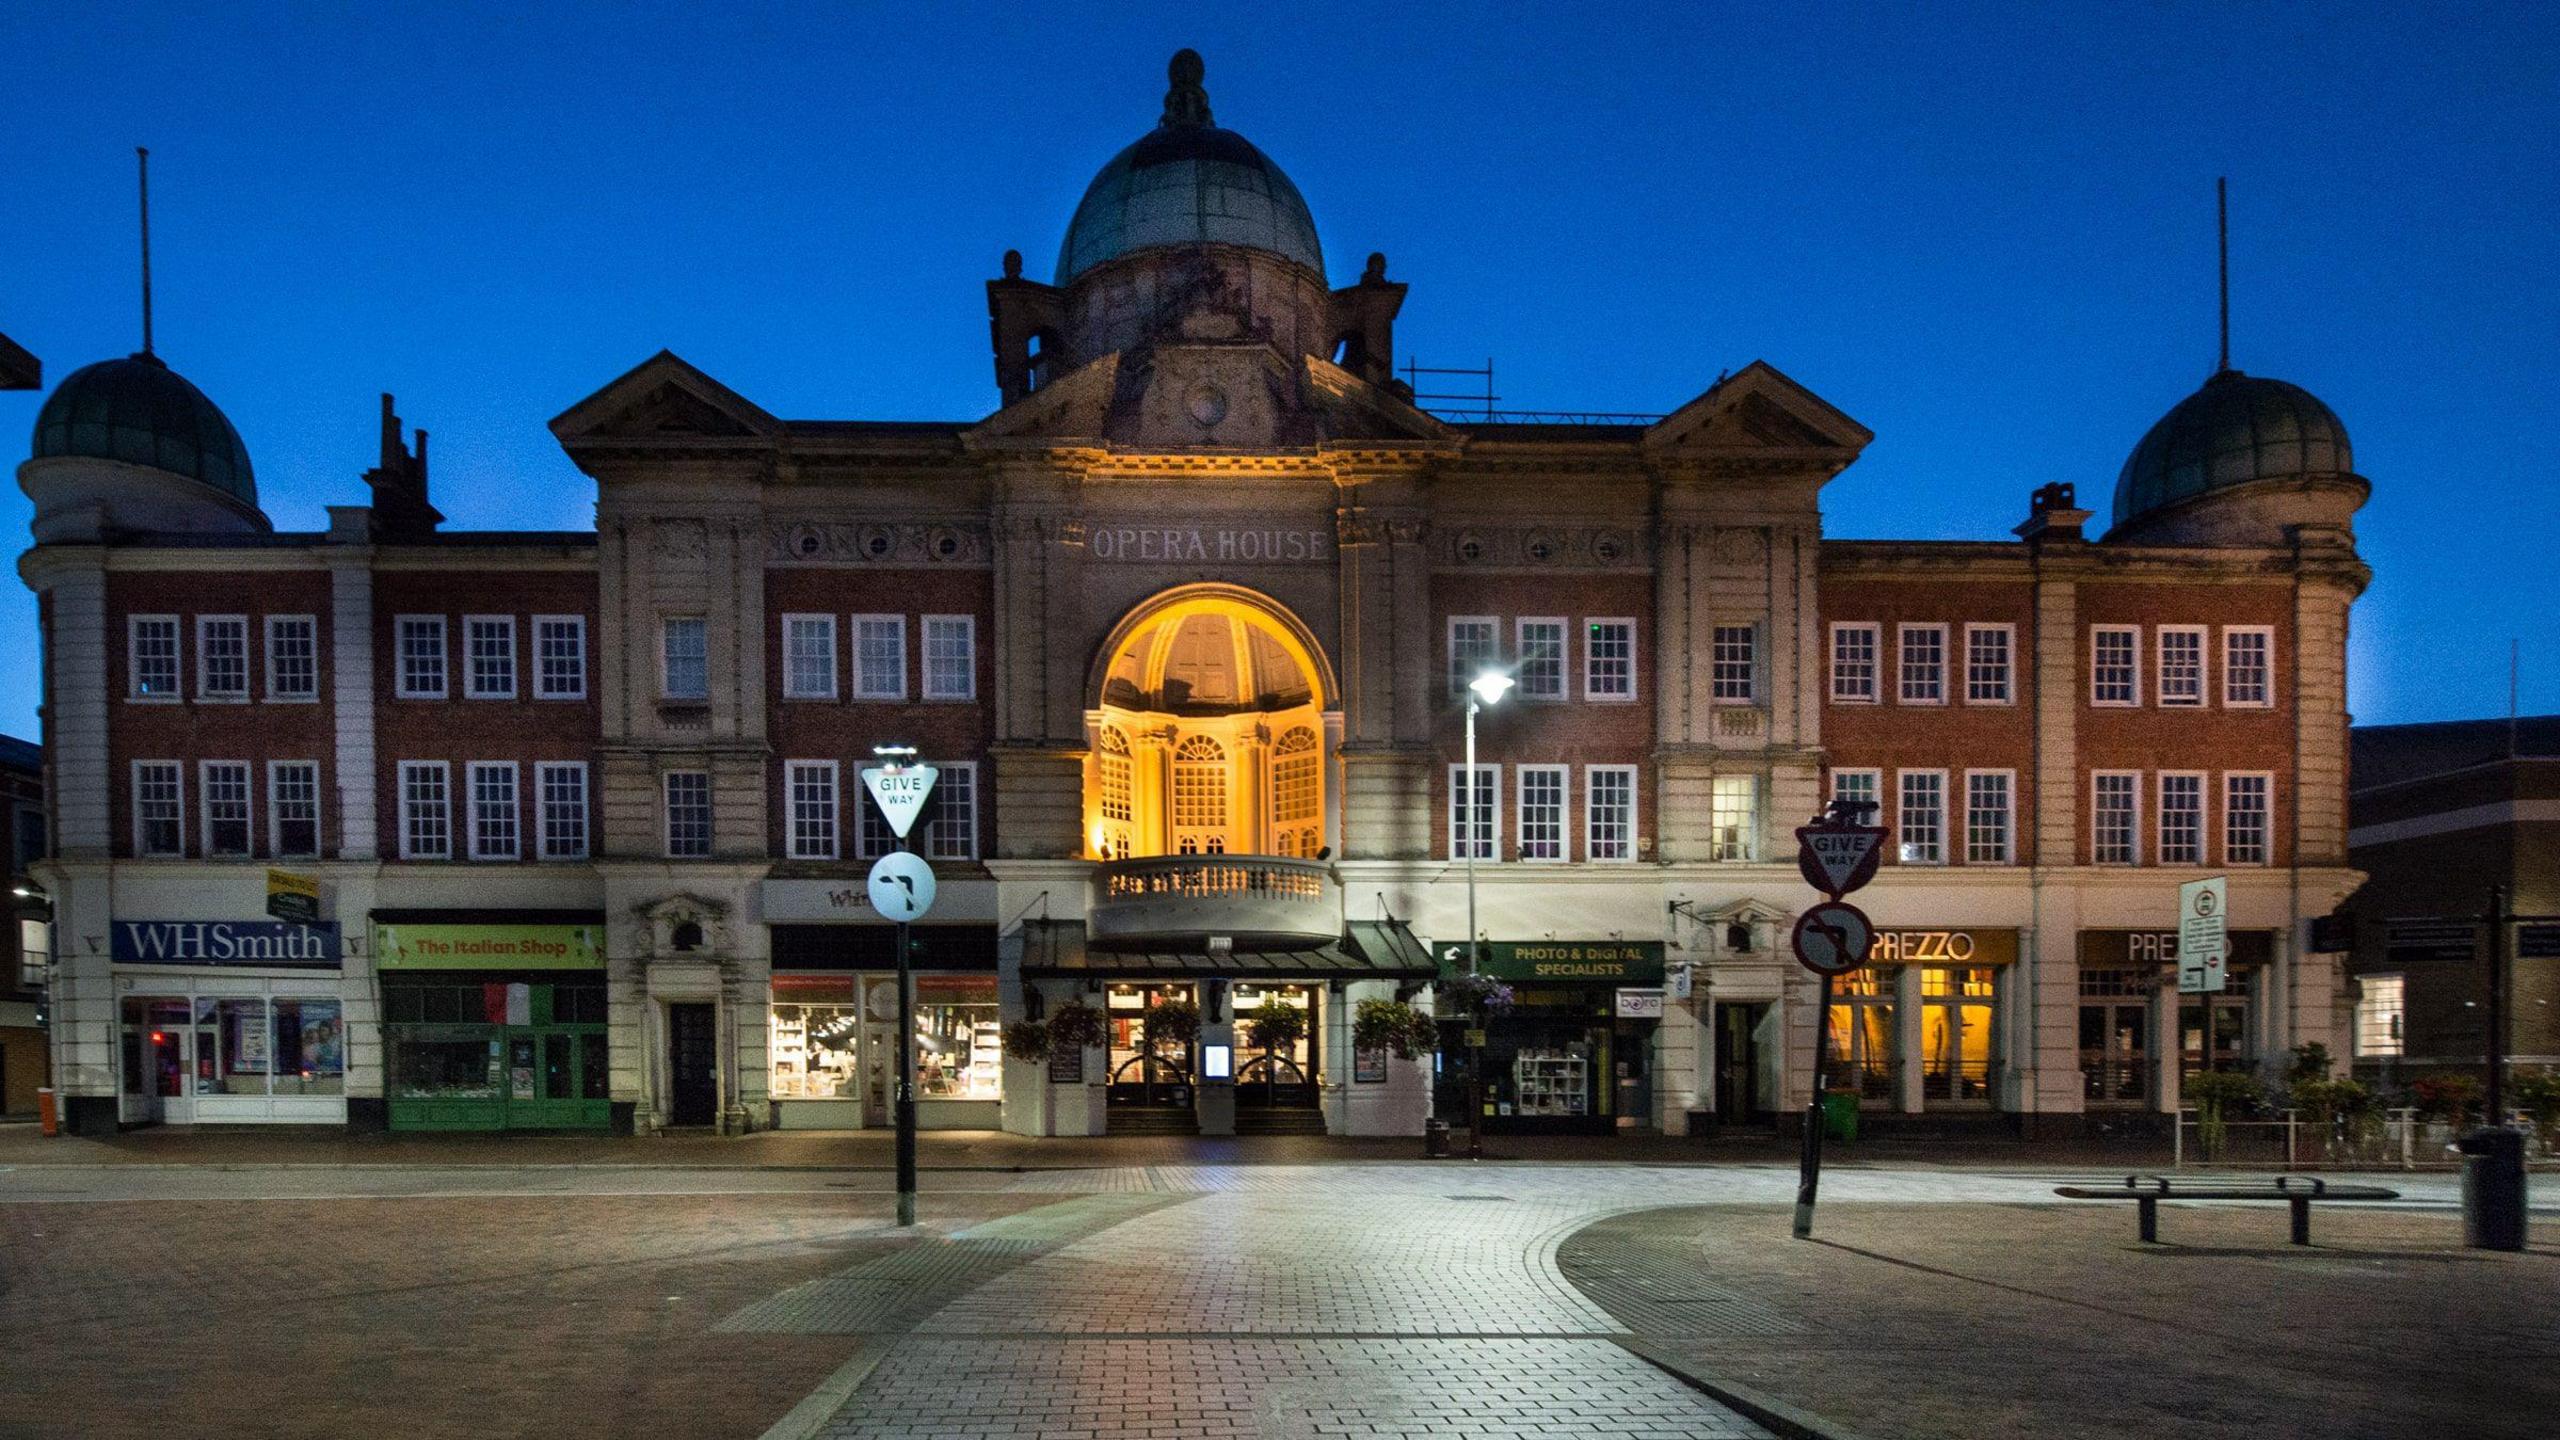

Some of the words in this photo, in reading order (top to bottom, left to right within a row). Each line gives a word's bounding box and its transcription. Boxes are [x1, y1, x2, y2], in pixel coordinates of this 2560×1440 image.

[1095, 529, 1207, 560] OPERA
[1217, 530, 1328, 560] HOUSE
[880, 778, 922, 791] GIVE
[888, 795, 914, 805] WAY
[1815, 837, 1866, 852] GIVE
[1825, 856, 1857, 866] WAY
[126, 923, 325, 959] WHSmith
[416, 940, 449, 954] The
[454, 939, 516, 954] Italian
[520, 940, 567, 957] Shop
[1870, 932, 1975, 961] PREZZO
[1515, 948, 1567, 960] PHOTO
[1570, 948, 1581, 960] &
[1586, 948, 1643, 960] DIGITAL
[1535, 964, 1624, 975] SPECIALISTS
